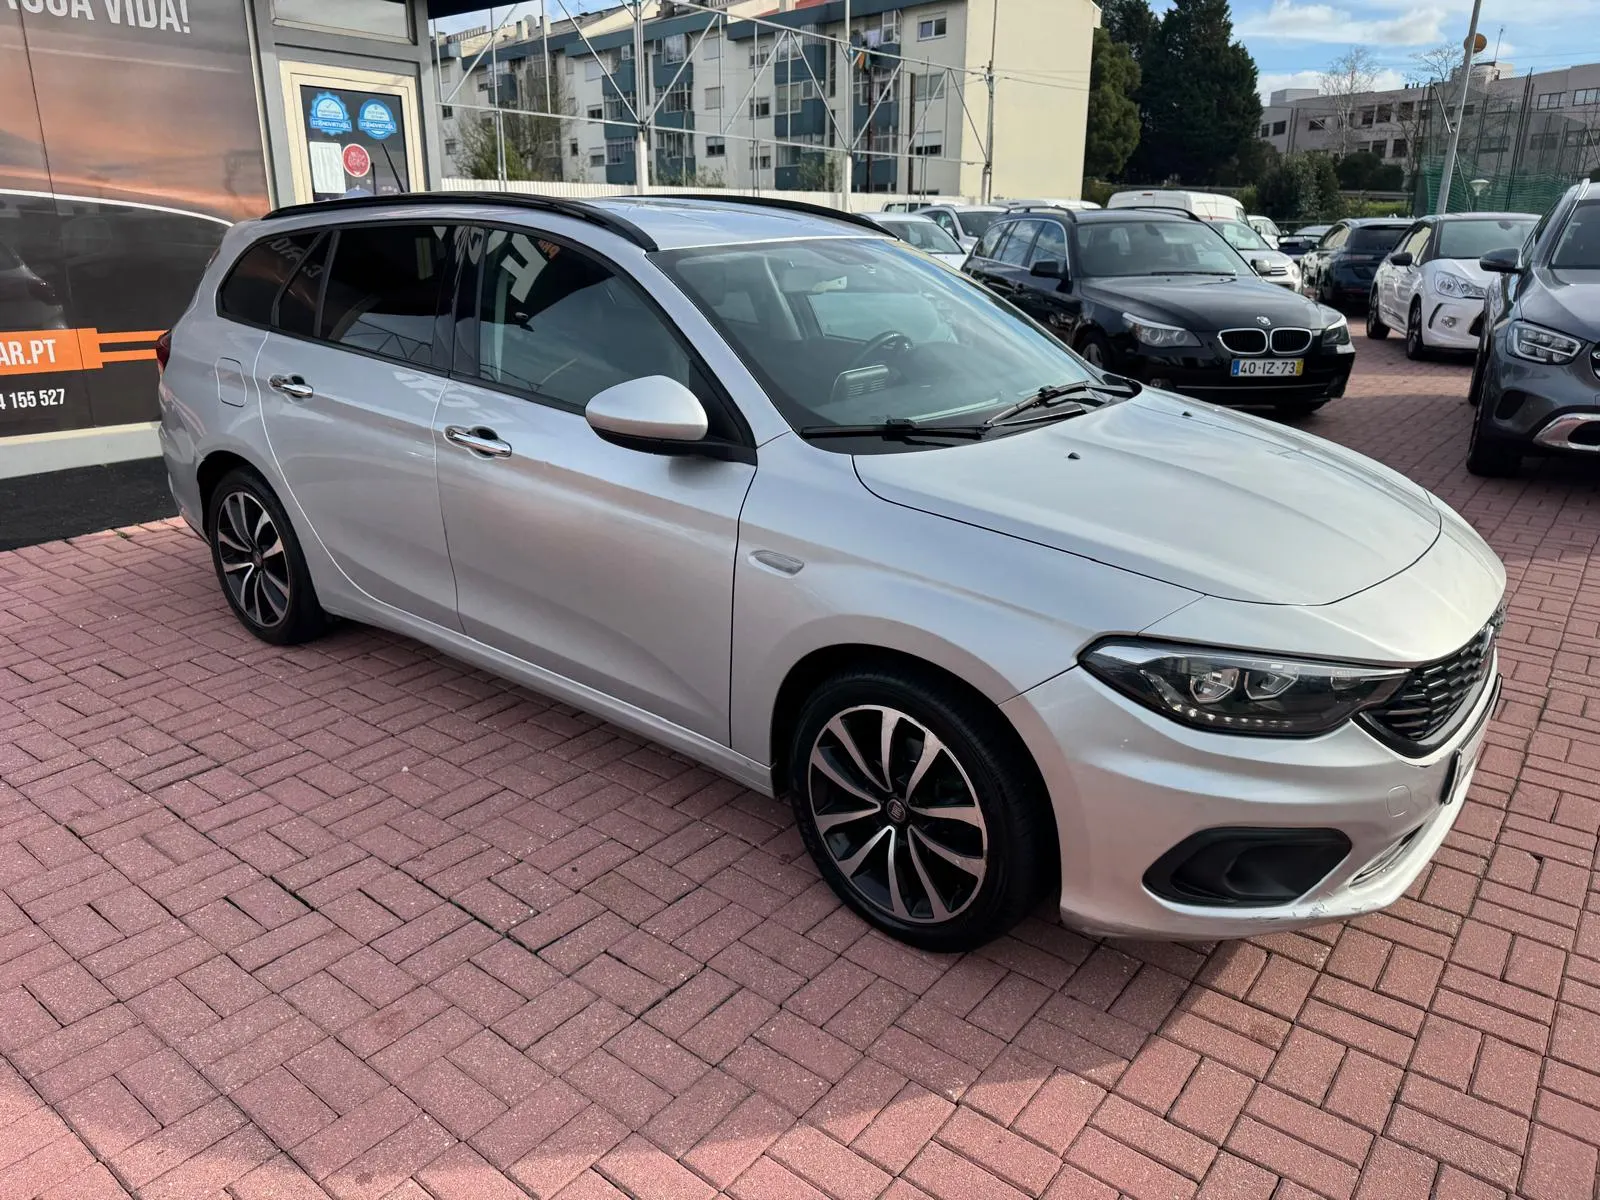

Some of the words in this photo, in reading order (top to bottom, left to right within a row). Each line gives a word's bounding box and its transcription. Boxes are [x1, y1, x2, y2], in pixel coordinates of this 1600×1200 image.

[104, 0, 191, 34] VIDA!
[9, 391, 37, 409] 155
[39, 388, 65, 407] 527
